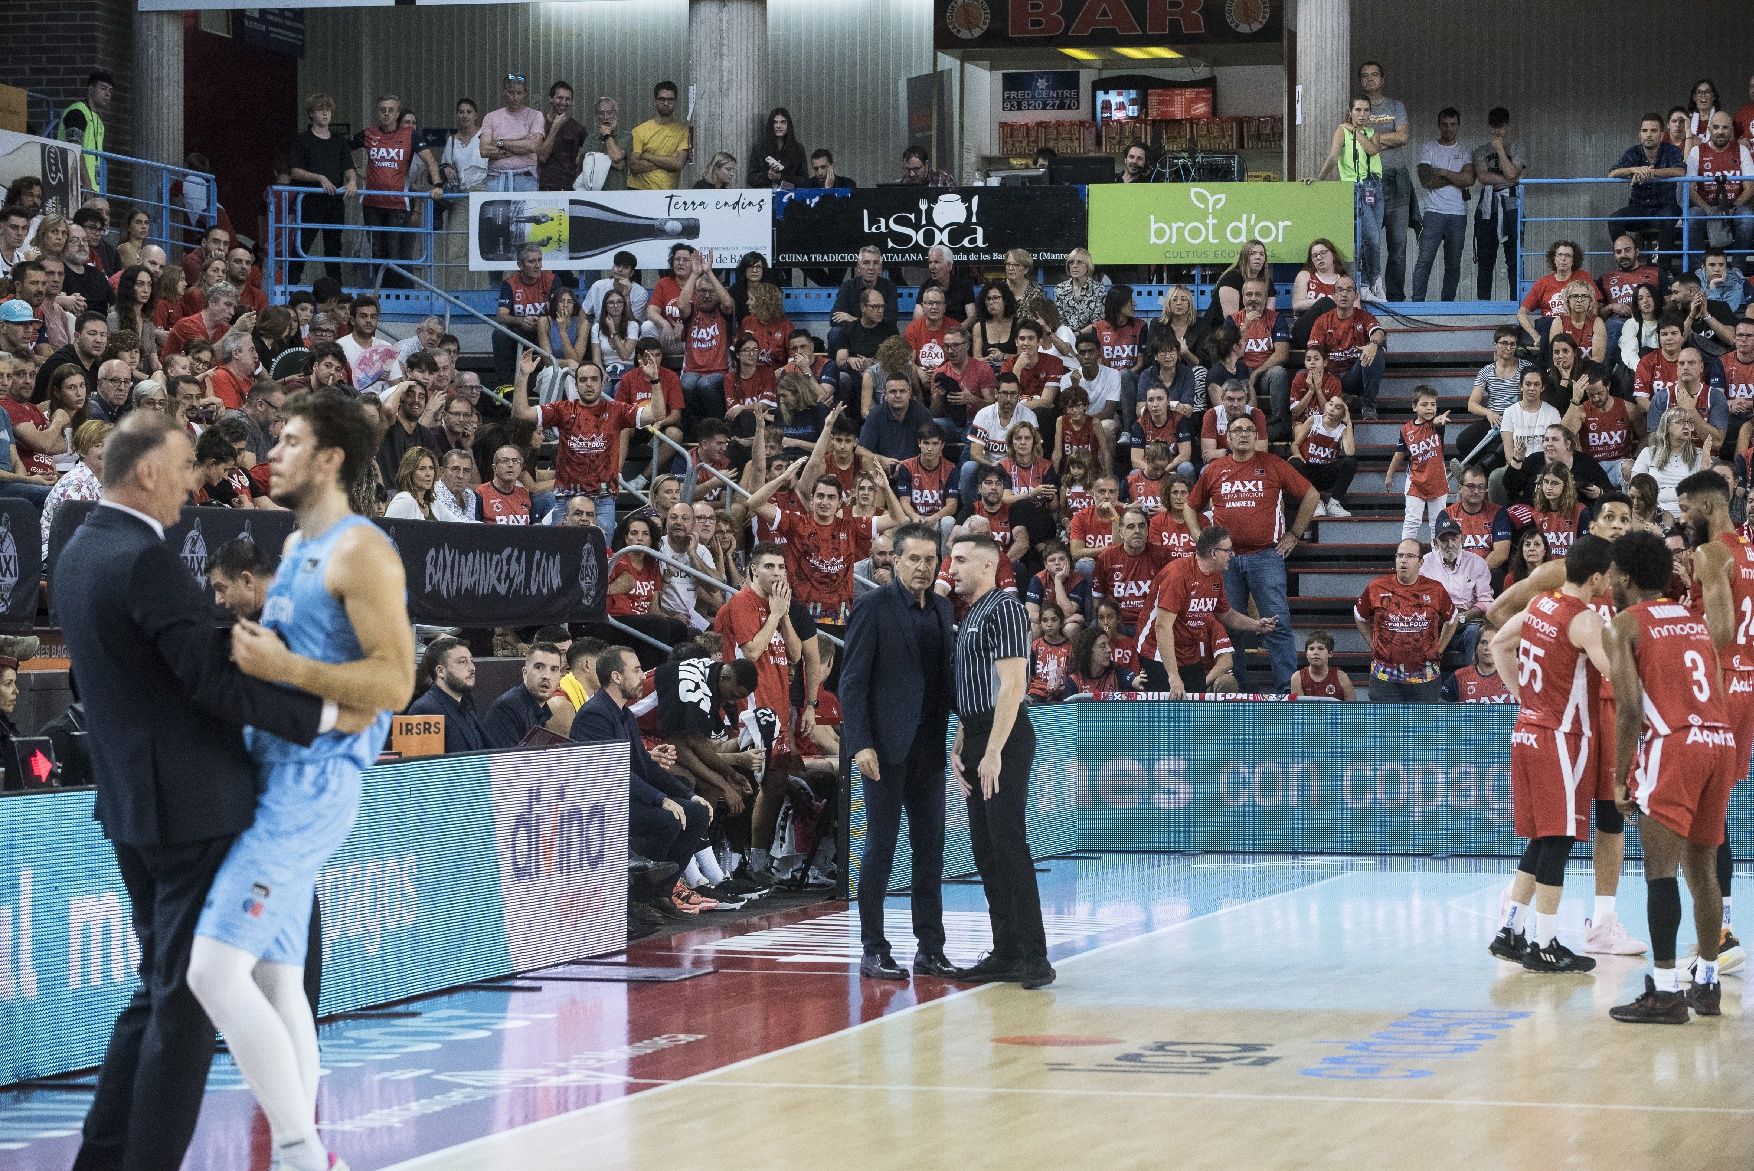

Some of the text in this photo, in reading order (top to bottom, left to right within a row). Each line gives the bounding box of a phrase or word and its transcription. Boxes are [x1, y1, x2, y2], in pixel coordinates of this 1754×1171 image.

[1008, 0, 1205, 37] BAR
[1004, 90, 1077, 99] FRED CENTRE
[1004, 100, 1077, 110] 93 820 27 70
[370, 148, 403, 160] BAXI
[664, 193, 766, 217] Terra endins
[863, 208, 988, 249] la Soca
[1150, 211, 1292, 244] brot d'or
[716, 254, 728, 264] de
[779, 254, 808, 262] CUINA
[811, 253, 860, 262] TRADICION
[880, 253, 922, 262] ATALANA
[1040, 252, 1068, 260] (Manre
[1164, 250, 1208, 258] CULTIUS
[1103, 345, 1138, 358] BAXI
[1245, 337, 1274, 352] AXI
[920, 350, 943, 360] BAXI
[1728, 383, 1754, 398] BAX
[1409, 434, 1440, 456] BAXI
[1589, 430, 1627, 446] BAXI
[1221, 481, 1263, 494] BAXI
[992, 531, 1011, 544] XI
[1086, 534, 1112, 548] SAP
[1463, 534, 1492, 549] AXI
[424, 543, 562, 600] BAXIMANRESA.COM
[629, 580, 655, 595] APS
[1113, 580, 1151, 598] BAX
[1188, 598, 1217, 612] BAXI
[1736, 595, 1754, 645] 2
[1518, 639, 1545, 693] 55
[1684, 651, 1710, 702] 3
[1343, 760, 1516, 822] copag
[315, 852, 419, 964] pagos
